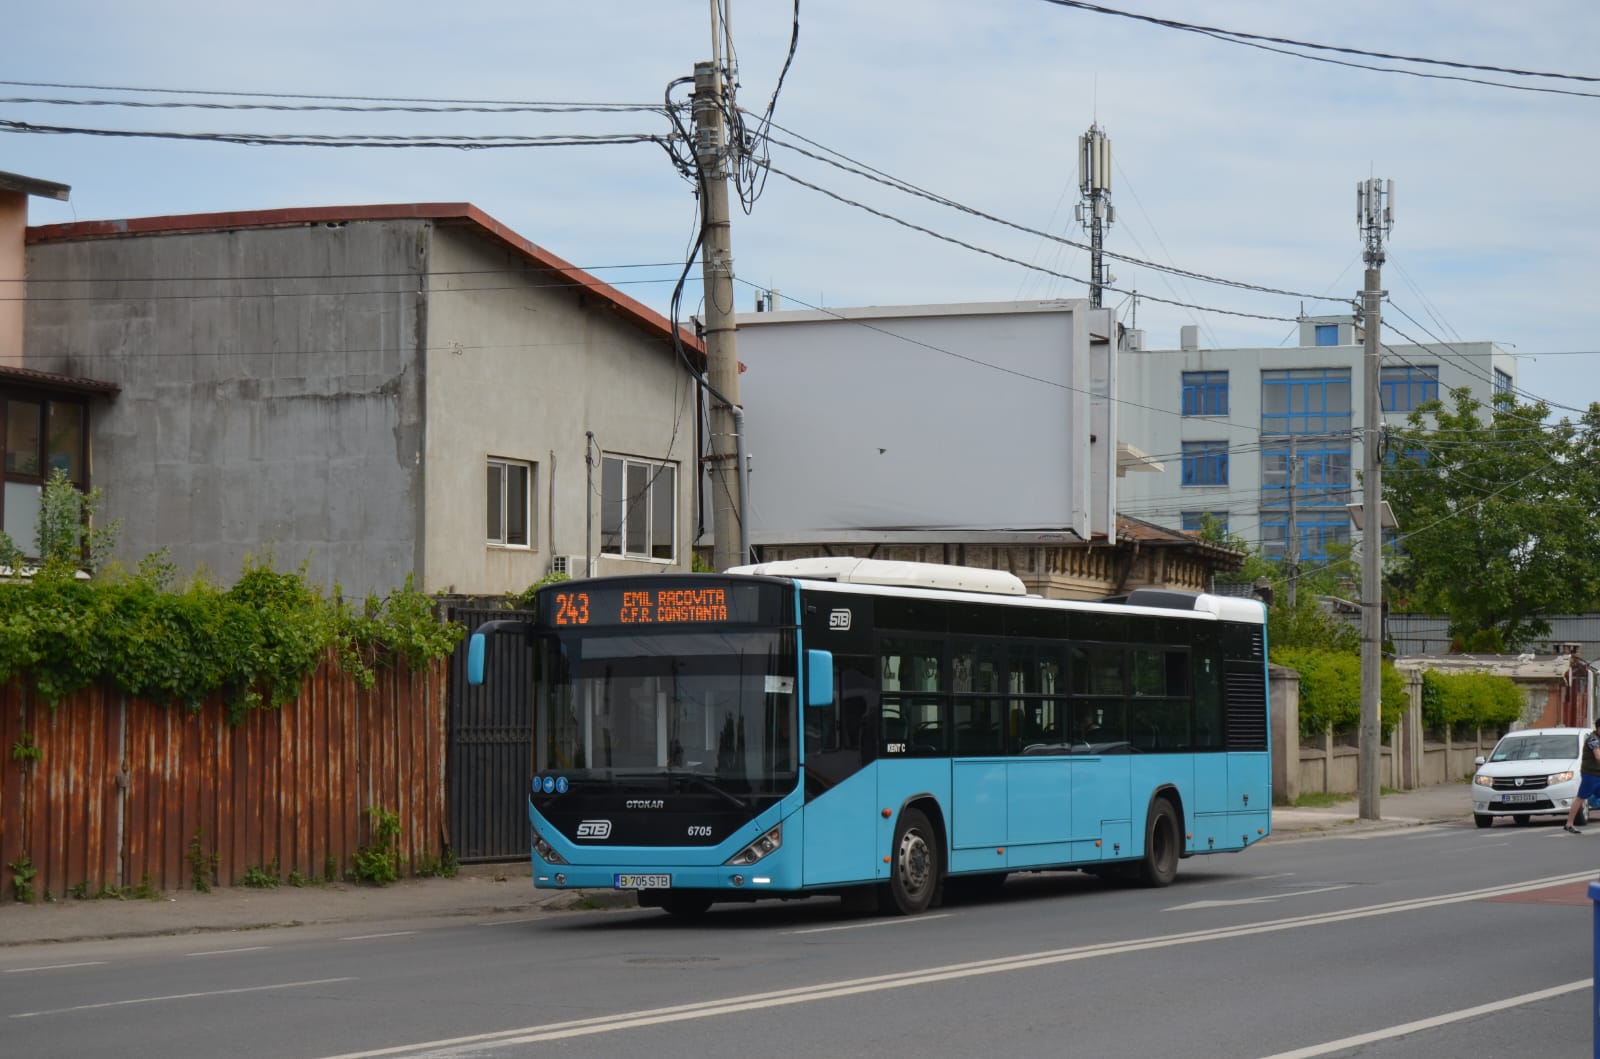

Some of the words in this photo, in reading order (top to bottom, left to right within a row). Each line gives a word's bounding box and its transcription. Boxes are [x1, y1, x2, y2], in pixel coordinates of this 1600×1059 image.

[623, 592, 652, 607] EMIL
[658, 589, 725, 606] RACOVITA
[556, 593, 589, 624] 243
[620, 608, 652, 622] C.F.R.
[657, 605, 727, 621] CONSTANTA
[830, 612, 849, 626] STB
[887, 744, 900, 752] KENT
[901, 744, 905, 752] C
[626, 800, 664, 809] OTOKAR
[577, 823, 609, 835] STB
[687, 826, 712, 836] 6705
[620, 877, 627, 886] B
[630, 877, 647, 886] 705
[649, 877, 668, 886] STB
